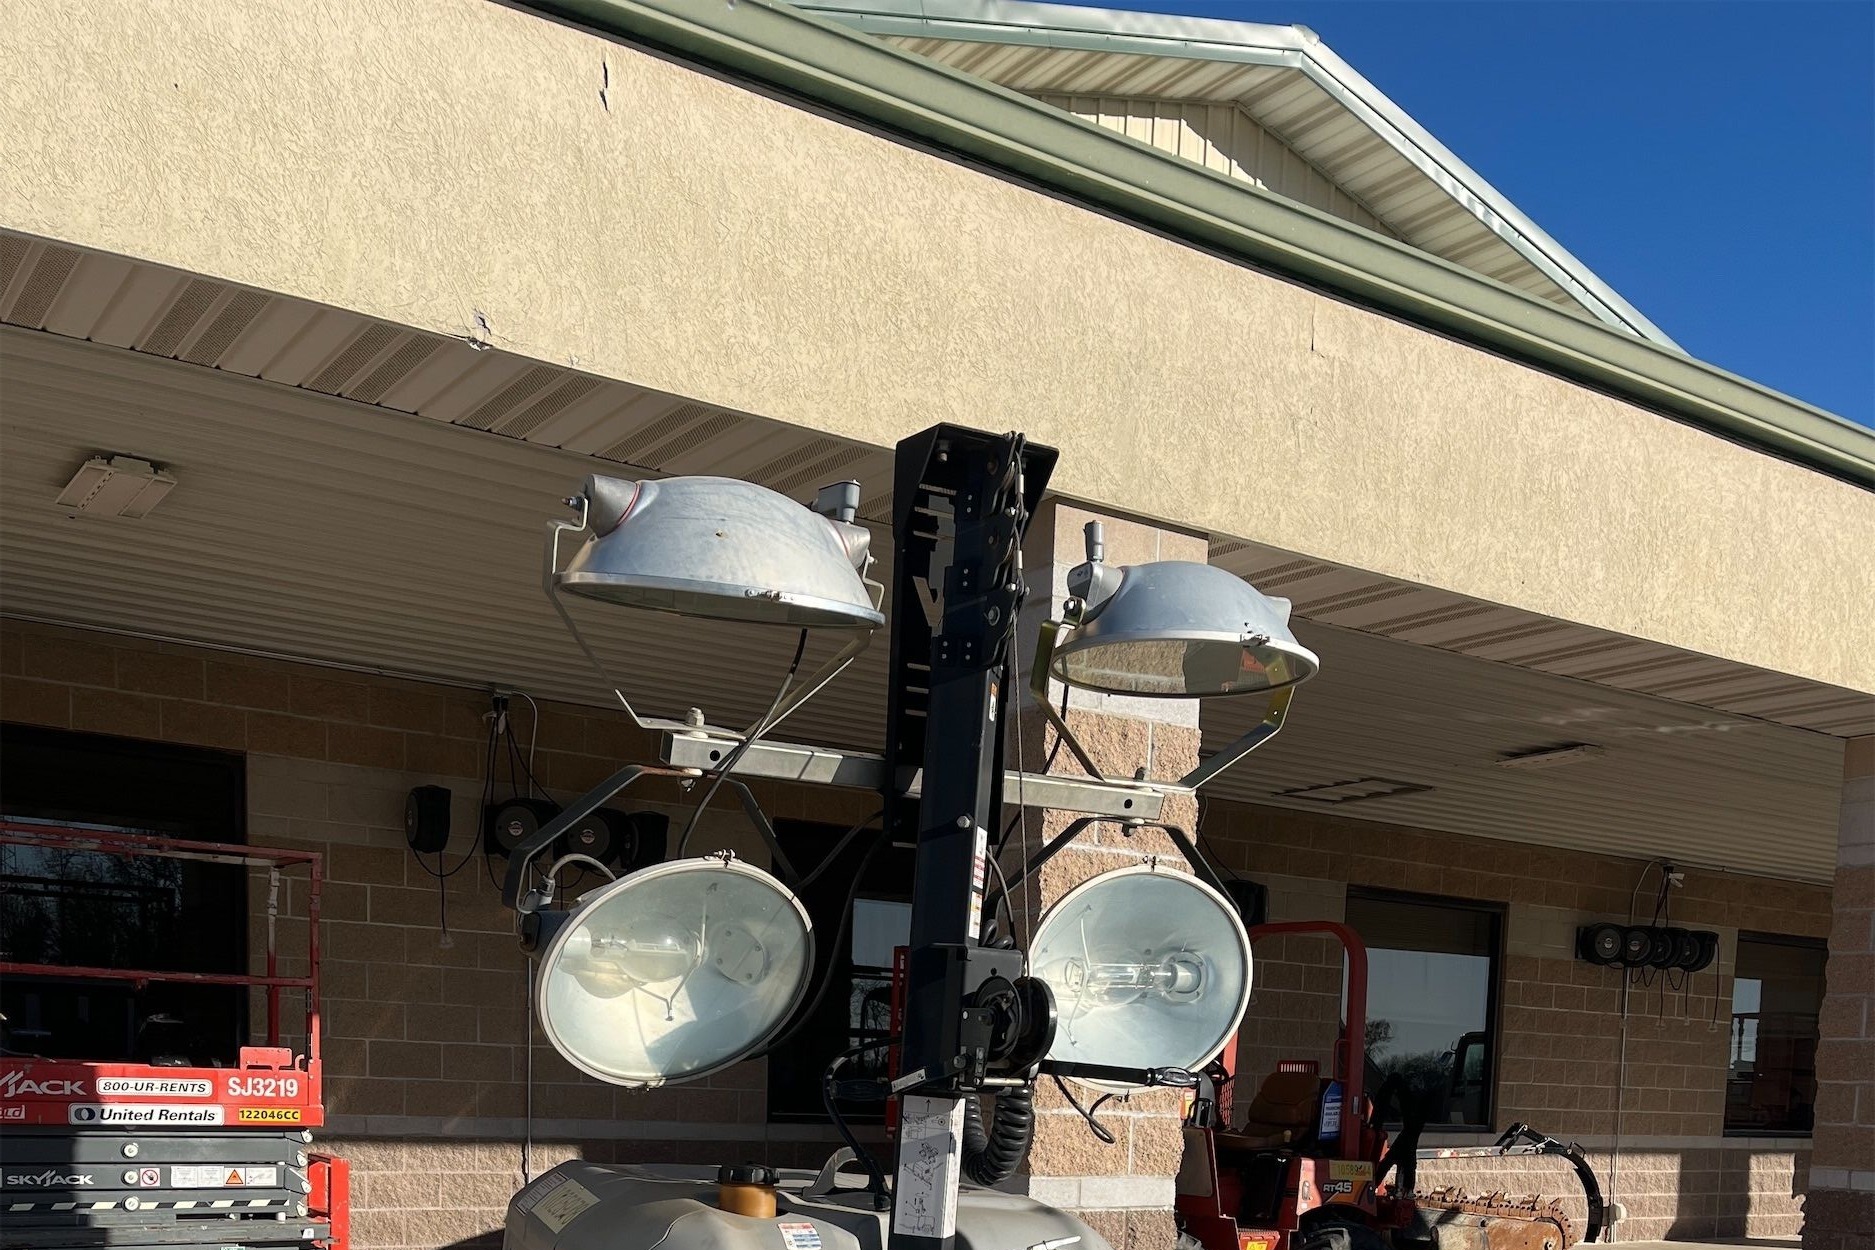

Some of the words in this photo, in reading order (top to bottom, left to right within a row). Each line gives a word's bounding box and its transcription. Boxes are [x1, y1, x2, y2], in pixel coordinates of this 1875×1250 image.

[103, 1081, 207, 1093] 800-UR-RENTS
[228, 1076, 299, 1098] SJ3219
[100, 1108, 153, 1121] United
[158, 1109, 216, 1122] Rentals
[239, 1110, 299, 1120] 122046CC
[6, 1169, 95, 1188] SKYJACK
[1323, 1181, 1352, 1193] RT45
